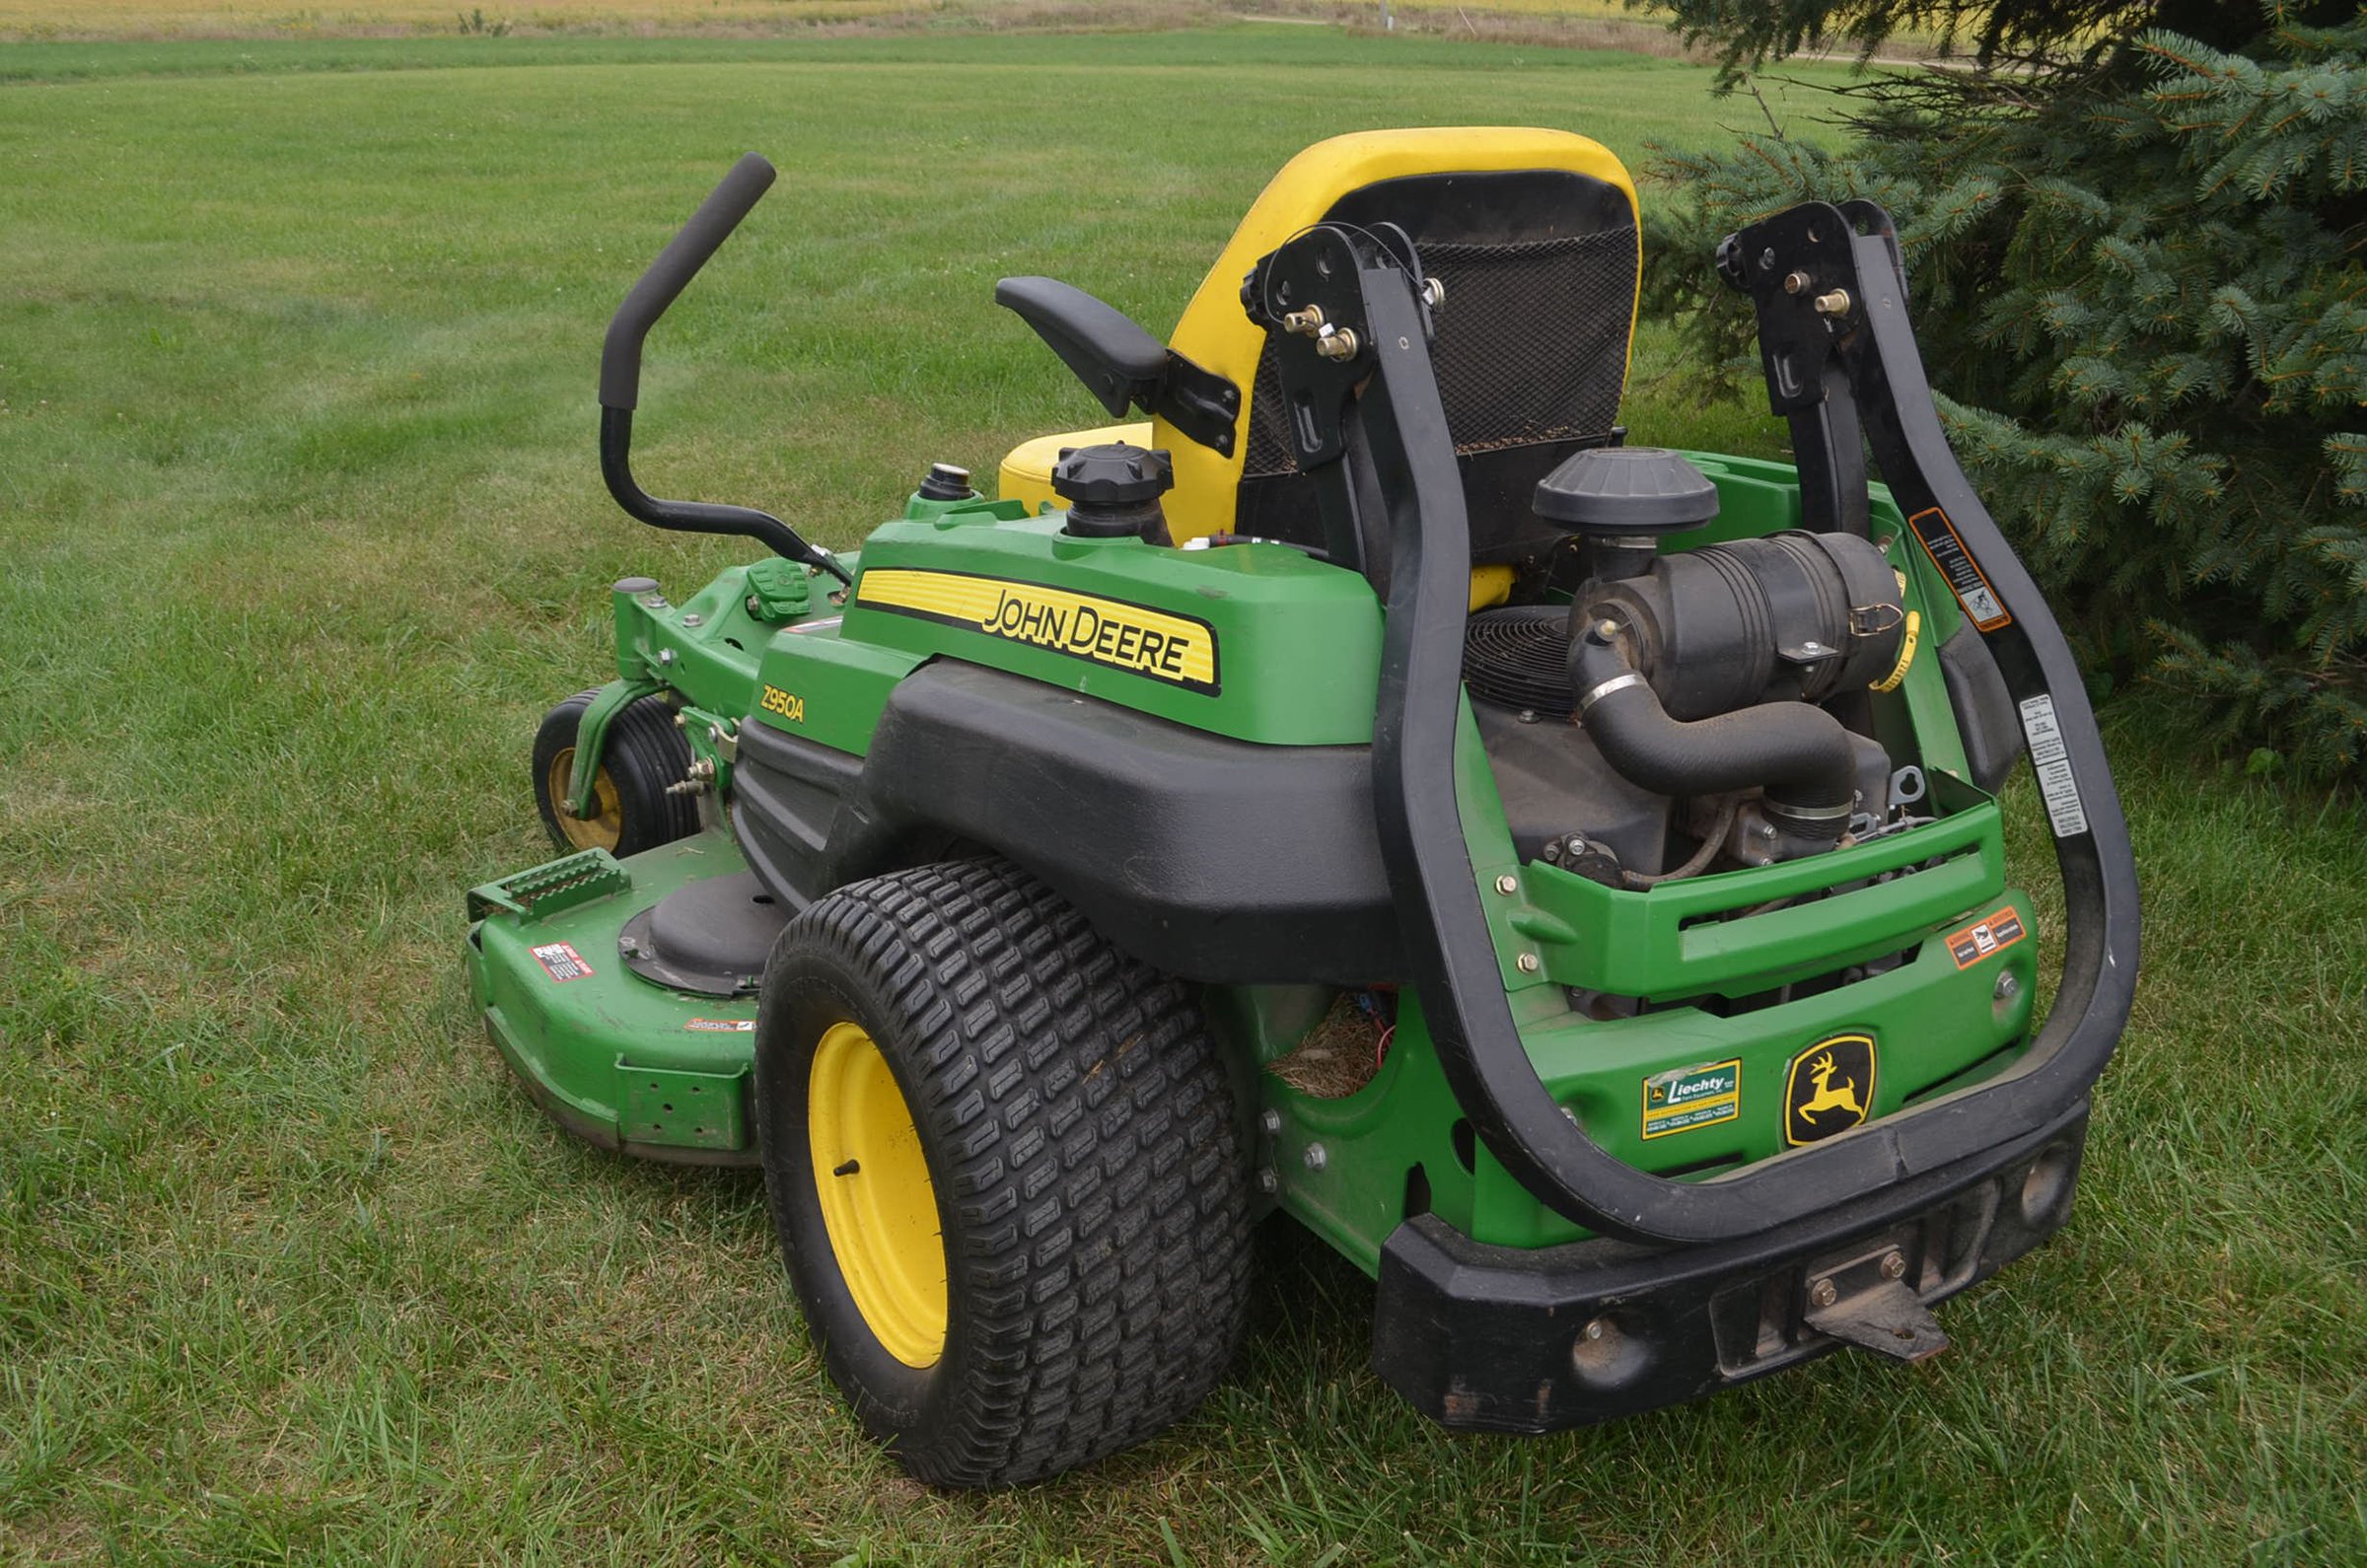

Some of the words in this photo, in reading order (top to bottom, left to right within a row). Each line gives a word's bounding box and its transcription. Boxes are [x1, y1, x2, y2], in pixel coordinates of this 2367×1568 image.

[984, 589, 1067, 644] JOHN
[1069, 606, 1190, 674] DEERE
[760, 682, 805, 724] Z950A
[1667, 1077, 1725, 1104] Liechty
